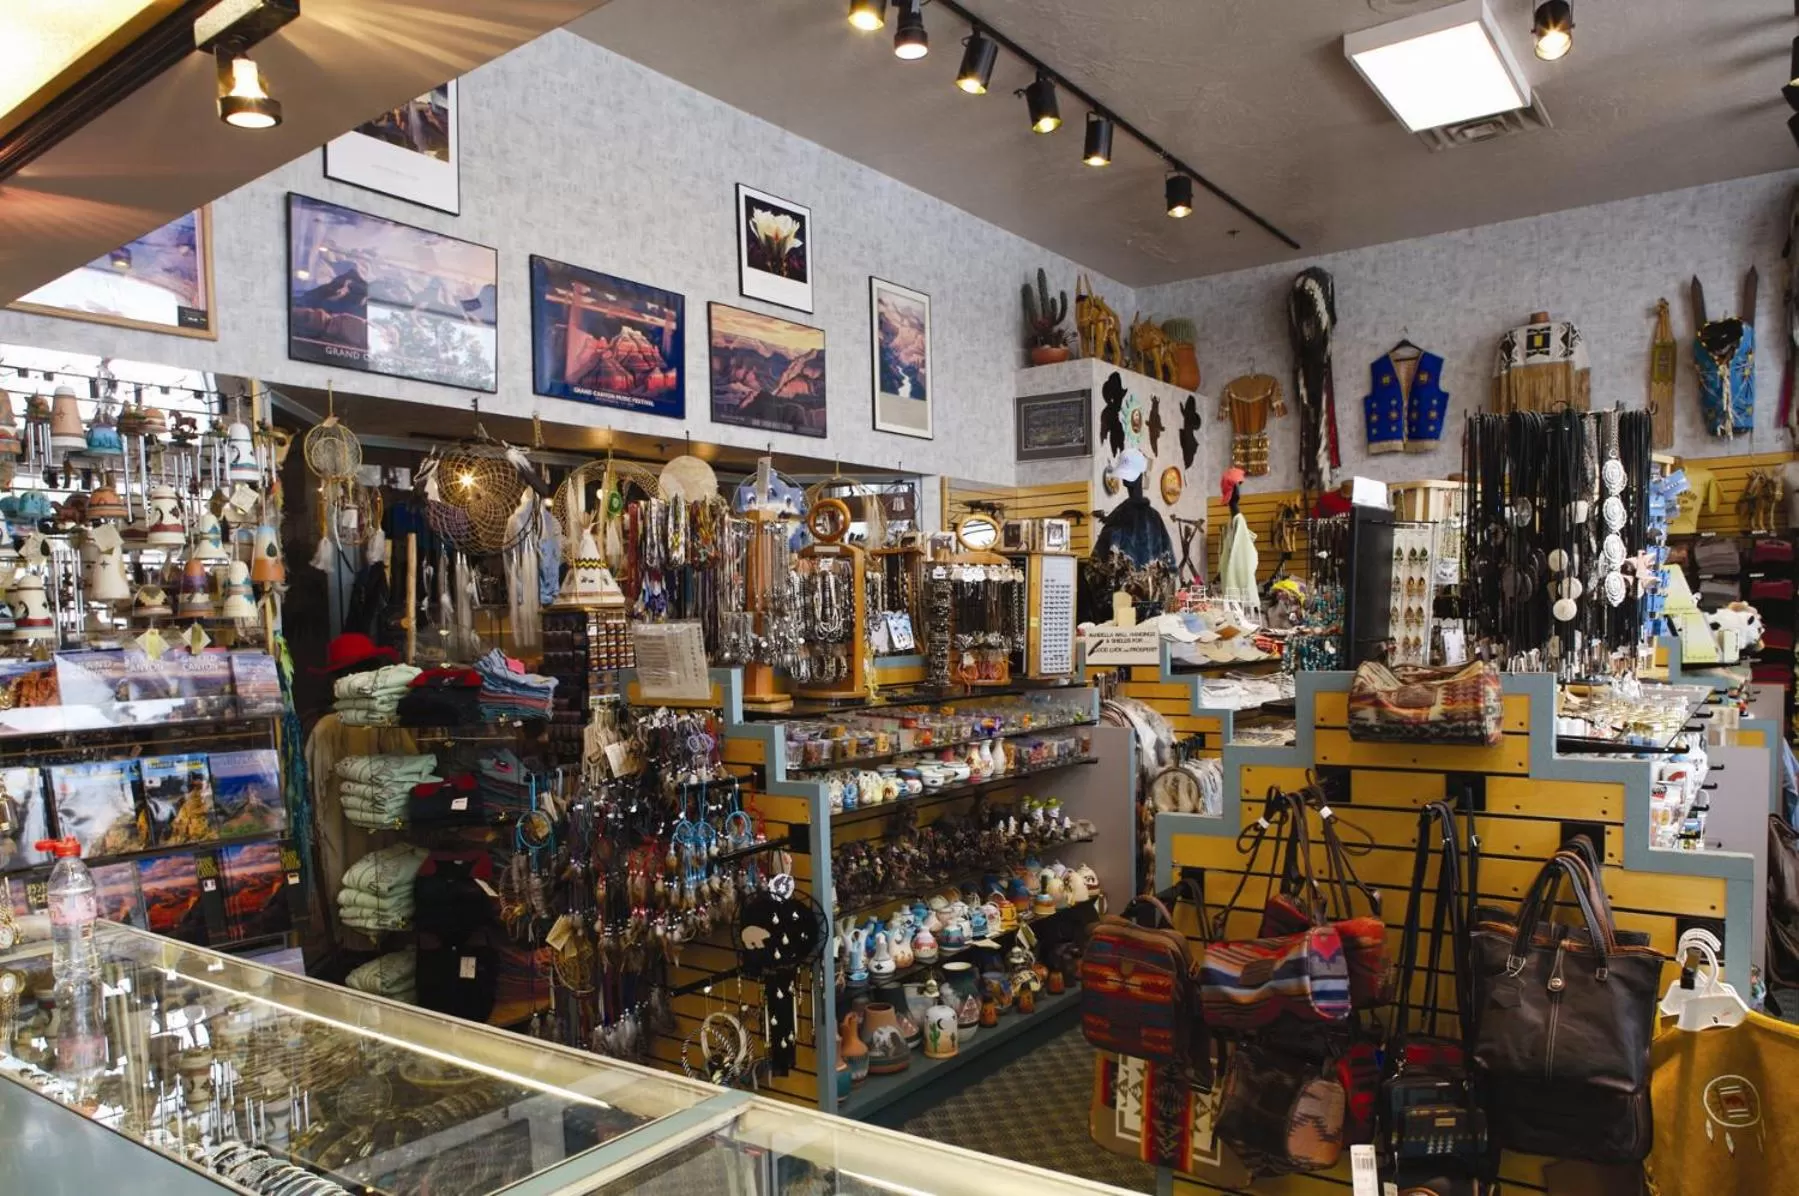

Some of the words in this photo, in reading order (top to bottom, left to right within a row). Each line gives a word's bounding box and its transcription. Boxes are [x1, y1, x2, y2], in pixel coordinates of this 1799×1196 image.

[325, 346, 360, 360] GRAND
[574, 387, 592, 396] GRAND
[593, 390, 615, 399] CANYON
[632, 397, 655, 407] FESTIVAL
[182, 663, 219, 672] CANYON
